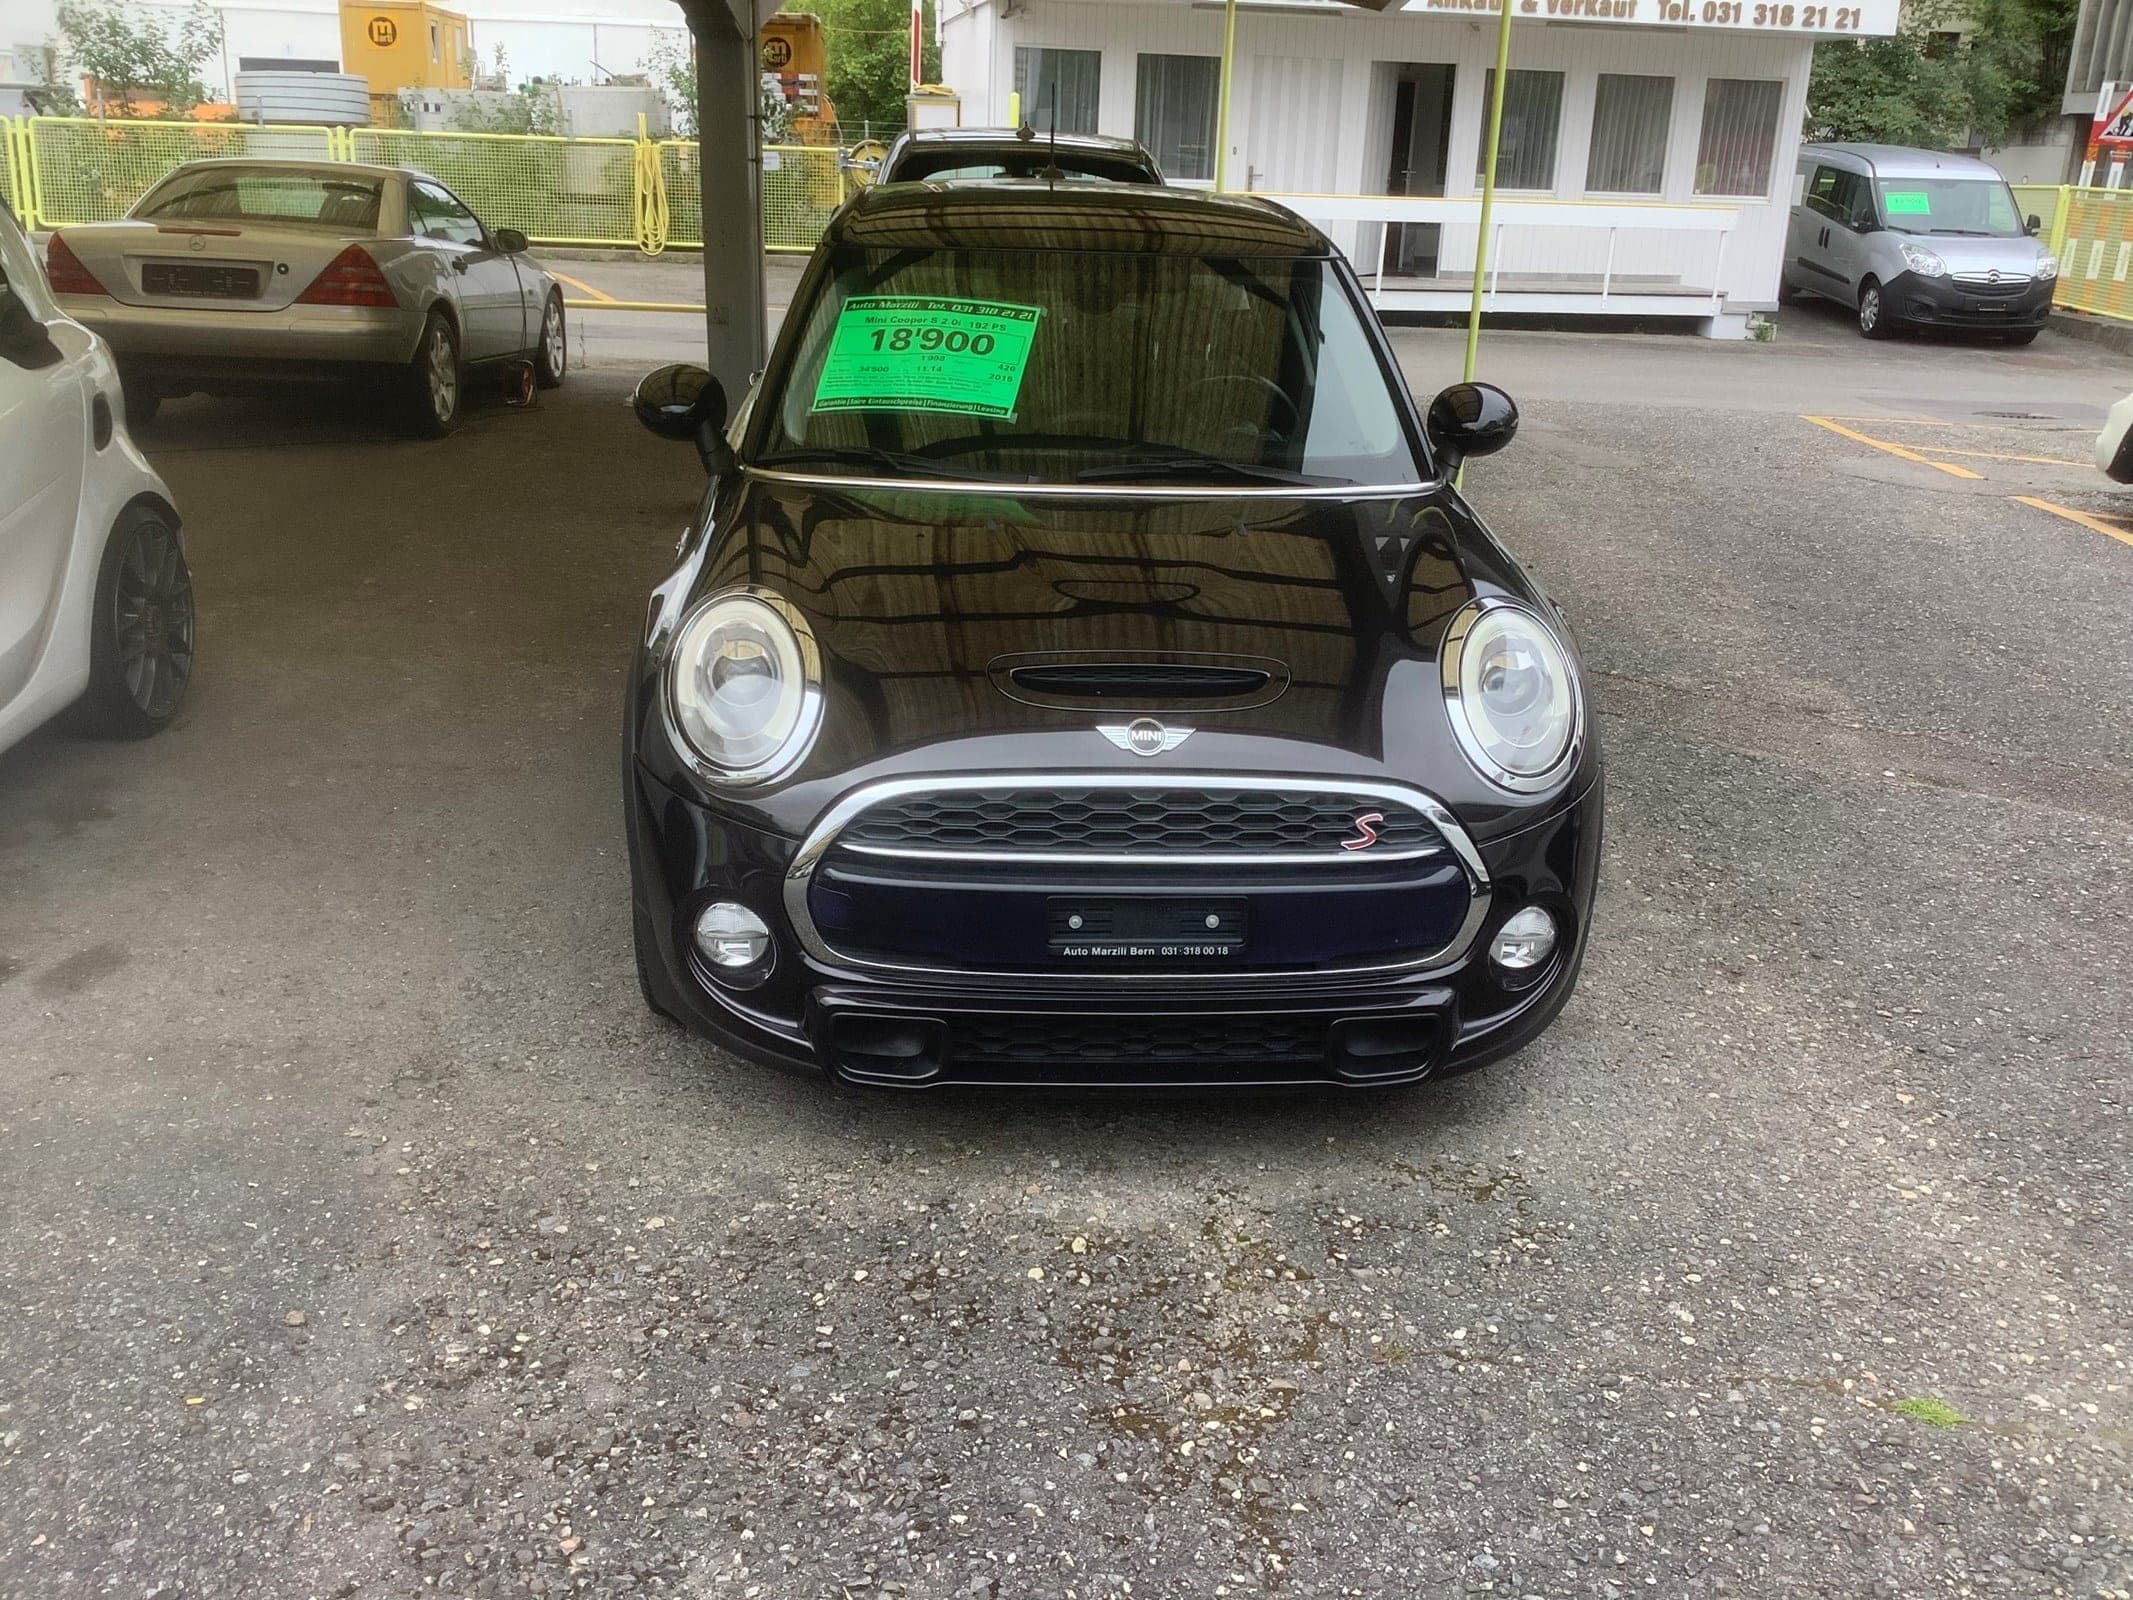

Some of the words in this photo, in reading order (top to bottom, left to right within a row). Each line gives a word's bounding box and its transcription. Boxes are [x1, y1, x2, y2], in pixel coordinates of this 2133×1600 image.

[1546, 0, 1638, 18] Verkauf
[1657, 0, 1696, 21] Tel.
[1702, 1, 1743, 24] 031
[1753, 3, 1795, 26] 318
[1801, 6, 1828, 28] 21
[1834, 7, 1861, 30] 21
[848, 302, 875, 310] Auto
[928, 302, 947, 310] Tel.
[951, 304, 973, 313] 031
[1001, 309, 1015, 318] 21
[1019, 311, 1033, 320] 21
[864, 316, 887, 324] Mini
[890, 315, 928, 325] Cooper
[969, 321, 989, 330] 192
[991, 323, 1007, 331] PS
[871, 327, 995, 355] 18'900
[1131, 730, 1162, 741] MINI
[1063, 947, 1089, 956] Auto
[1091, 947, 1127, 956] Marzili
[1130, 947, 1155, 956] Bern
[1202, 946, 1215, 956] 00
[1218, 946, 1229, 956] 18
